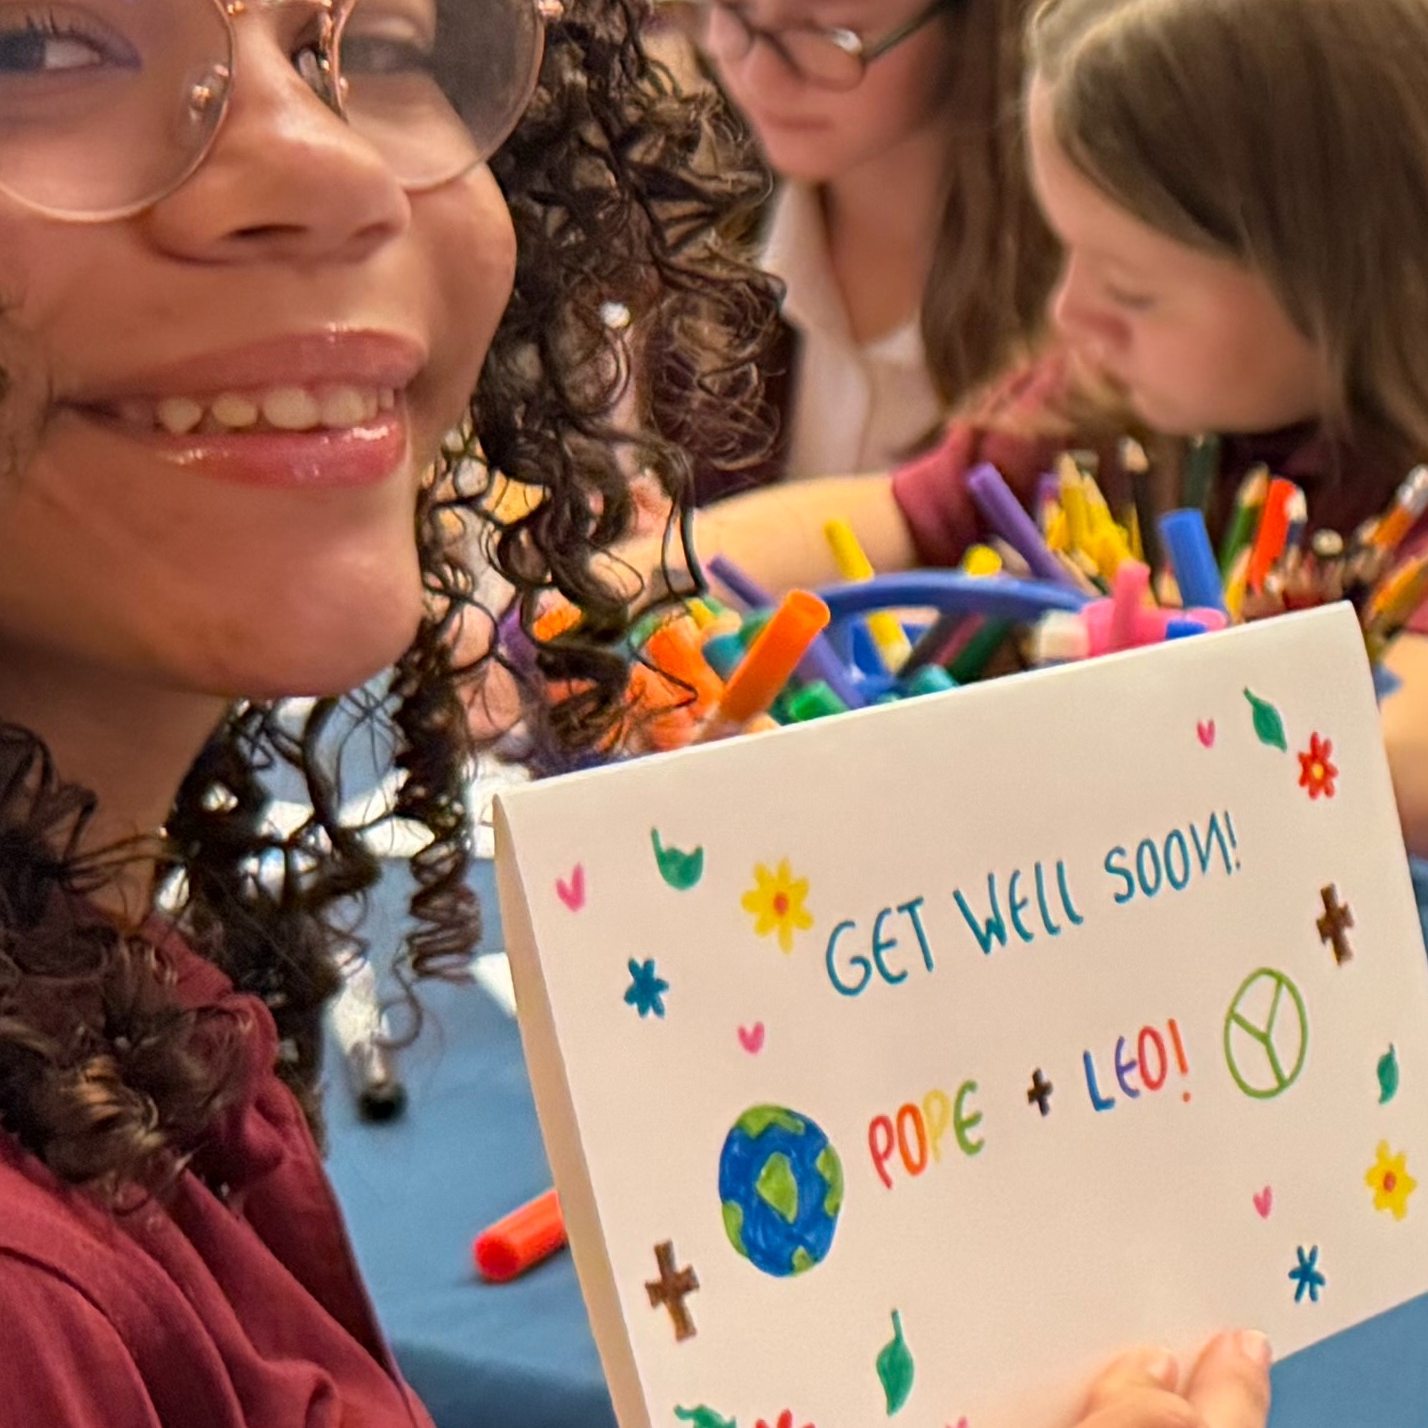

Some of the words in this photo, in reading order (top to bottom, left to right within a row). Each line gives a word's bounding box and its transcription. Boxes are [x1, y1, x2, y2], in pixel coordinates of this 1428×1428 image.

[825, 895, 935, 998] GET
[952, 858, 1085, 957] WELL
[1102, 809, 1242, 907] SOON!
[866, 1078, 985, 1191] POPE
[1081, 1017, 1193, 1114] LEO!
